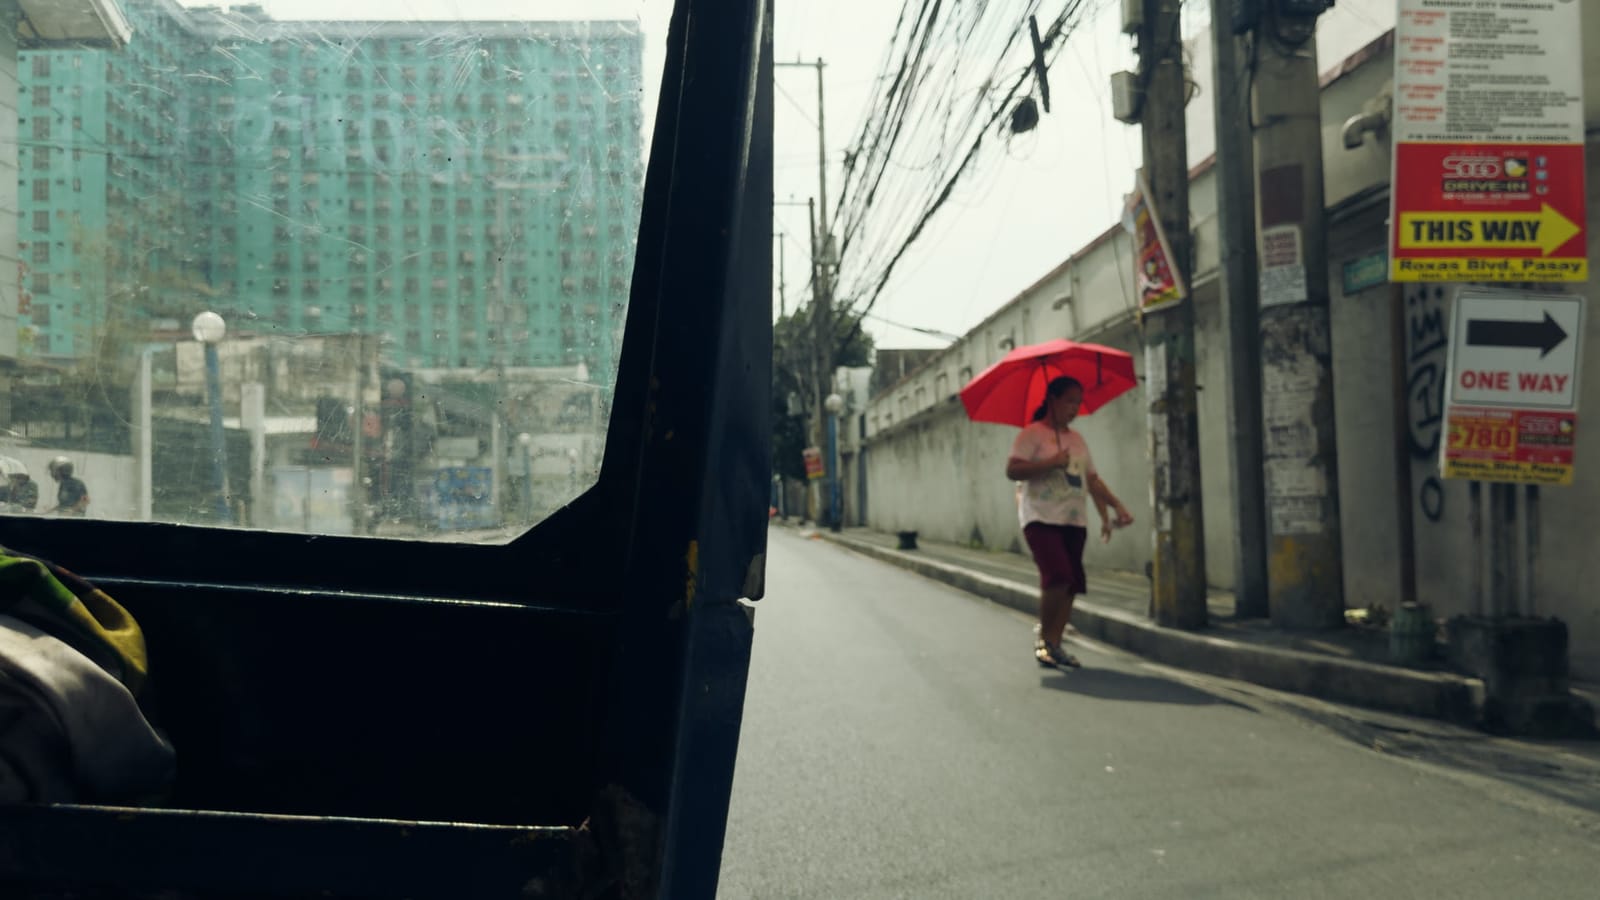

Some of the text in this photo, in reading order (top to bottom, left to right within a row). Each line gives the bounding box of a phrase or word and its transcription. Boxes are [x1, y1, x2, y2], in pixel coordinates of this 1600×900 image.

[1411, 219, 1541, 242] THIS WAY
[1400, 259, 1460, 271] Roxas
[1522, 259, 1581, 272] Pasay
[1460, 369, 1569, 393] ONE WAY
